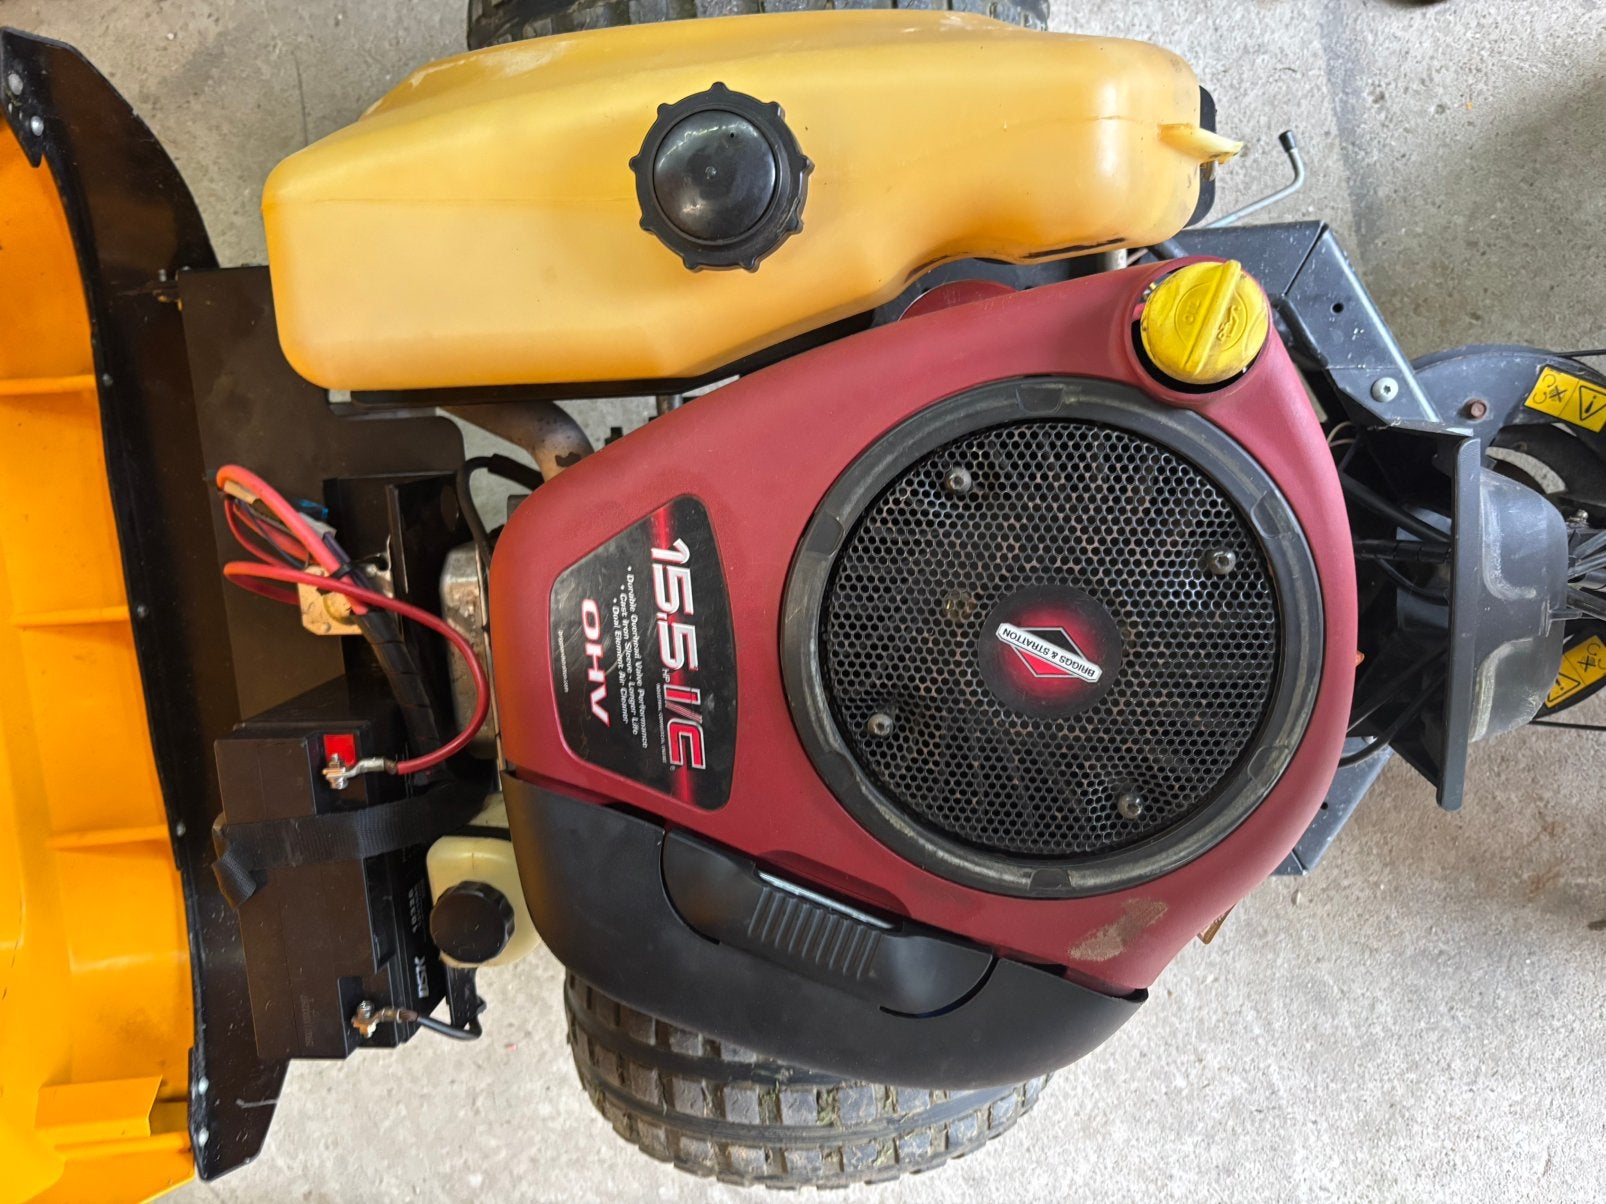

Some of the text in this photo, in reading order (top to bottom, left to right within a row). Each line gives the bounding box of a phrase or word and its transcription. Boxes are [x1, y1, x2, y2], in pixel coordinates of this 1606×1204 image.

[1183, 298, 1201, 325] OIL
[619, 593, 628, 617] Cast
[651, 538, 699, 671] 15.5
[621, 619, 630, 640] Iron
[1001, 627, 1051, 656] STRATTON
[580, 597, 611, 729] OHV
[612, 606, 629, 725] Dual Element Air Cleaner
[624, 642, 633, 674] Sleeve
[626, 574, 649, 749] Durable Overhead Valve Performance
[1058, 654, 1096, 678] BRIGGS
[661, 668, 671, 683] HP
[627, 681, 637, 716] Longer
[631, 716, 639, 735] Life
